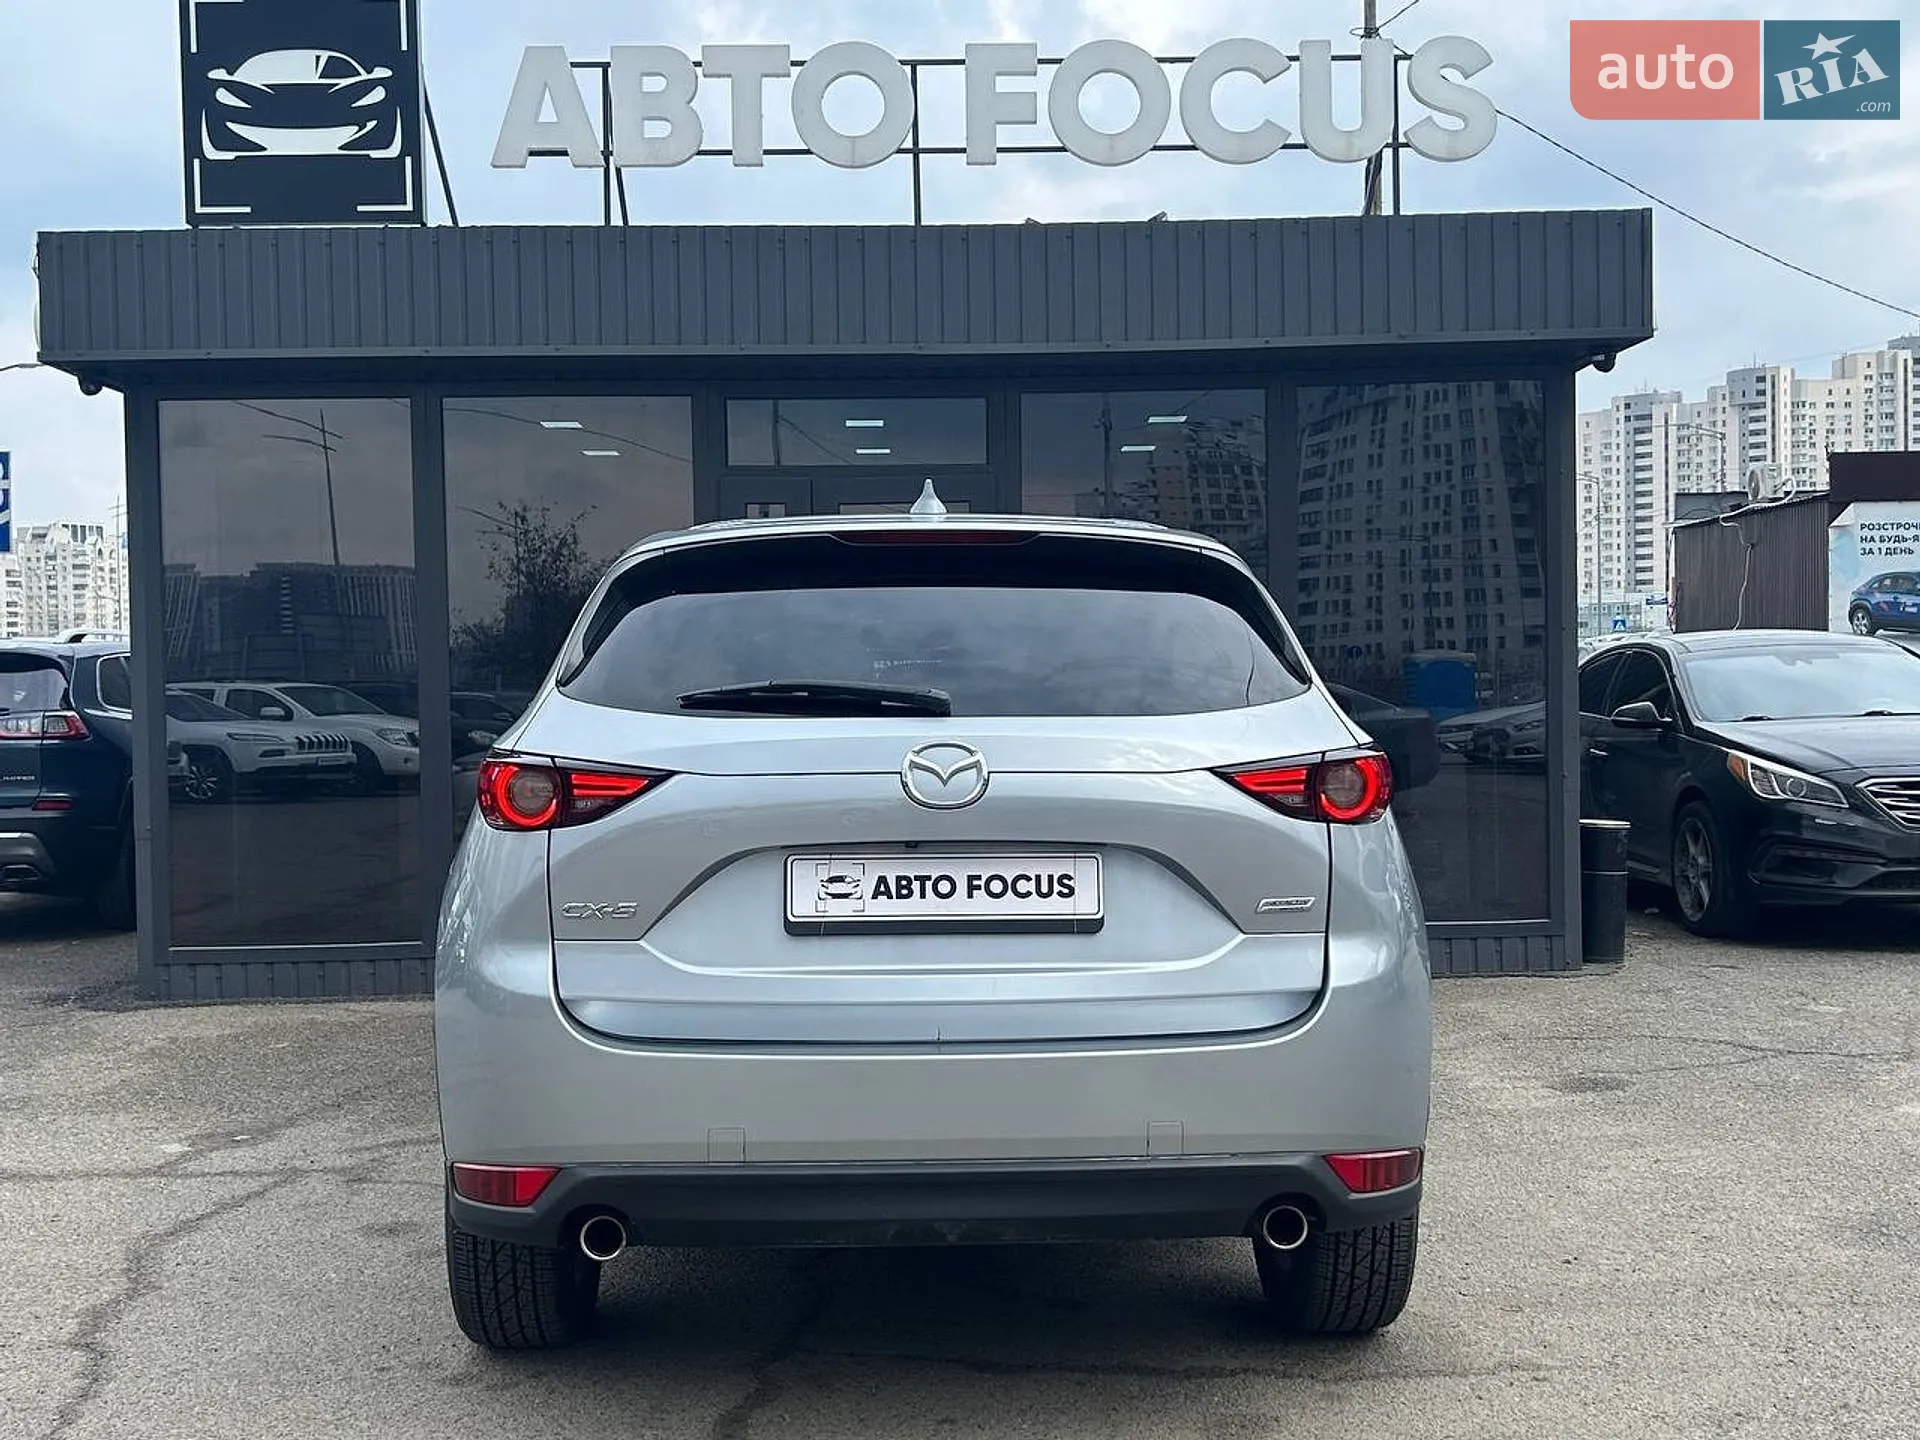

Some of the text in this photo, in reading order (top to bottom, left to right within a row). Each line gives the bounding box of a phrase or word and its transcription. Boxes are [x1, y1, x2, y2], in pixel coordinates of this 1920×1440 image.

[965, 36, 1498, 165] FOCUS
[1860, 535, 1876, 543] НА
[1860, 547, 1875, 556] ЗА
[1885, 547, 1914, 556] ДЕНЬ
[967, 873, 1076, 899] FOCUS
[562, 902, 637, 919] CX-5
